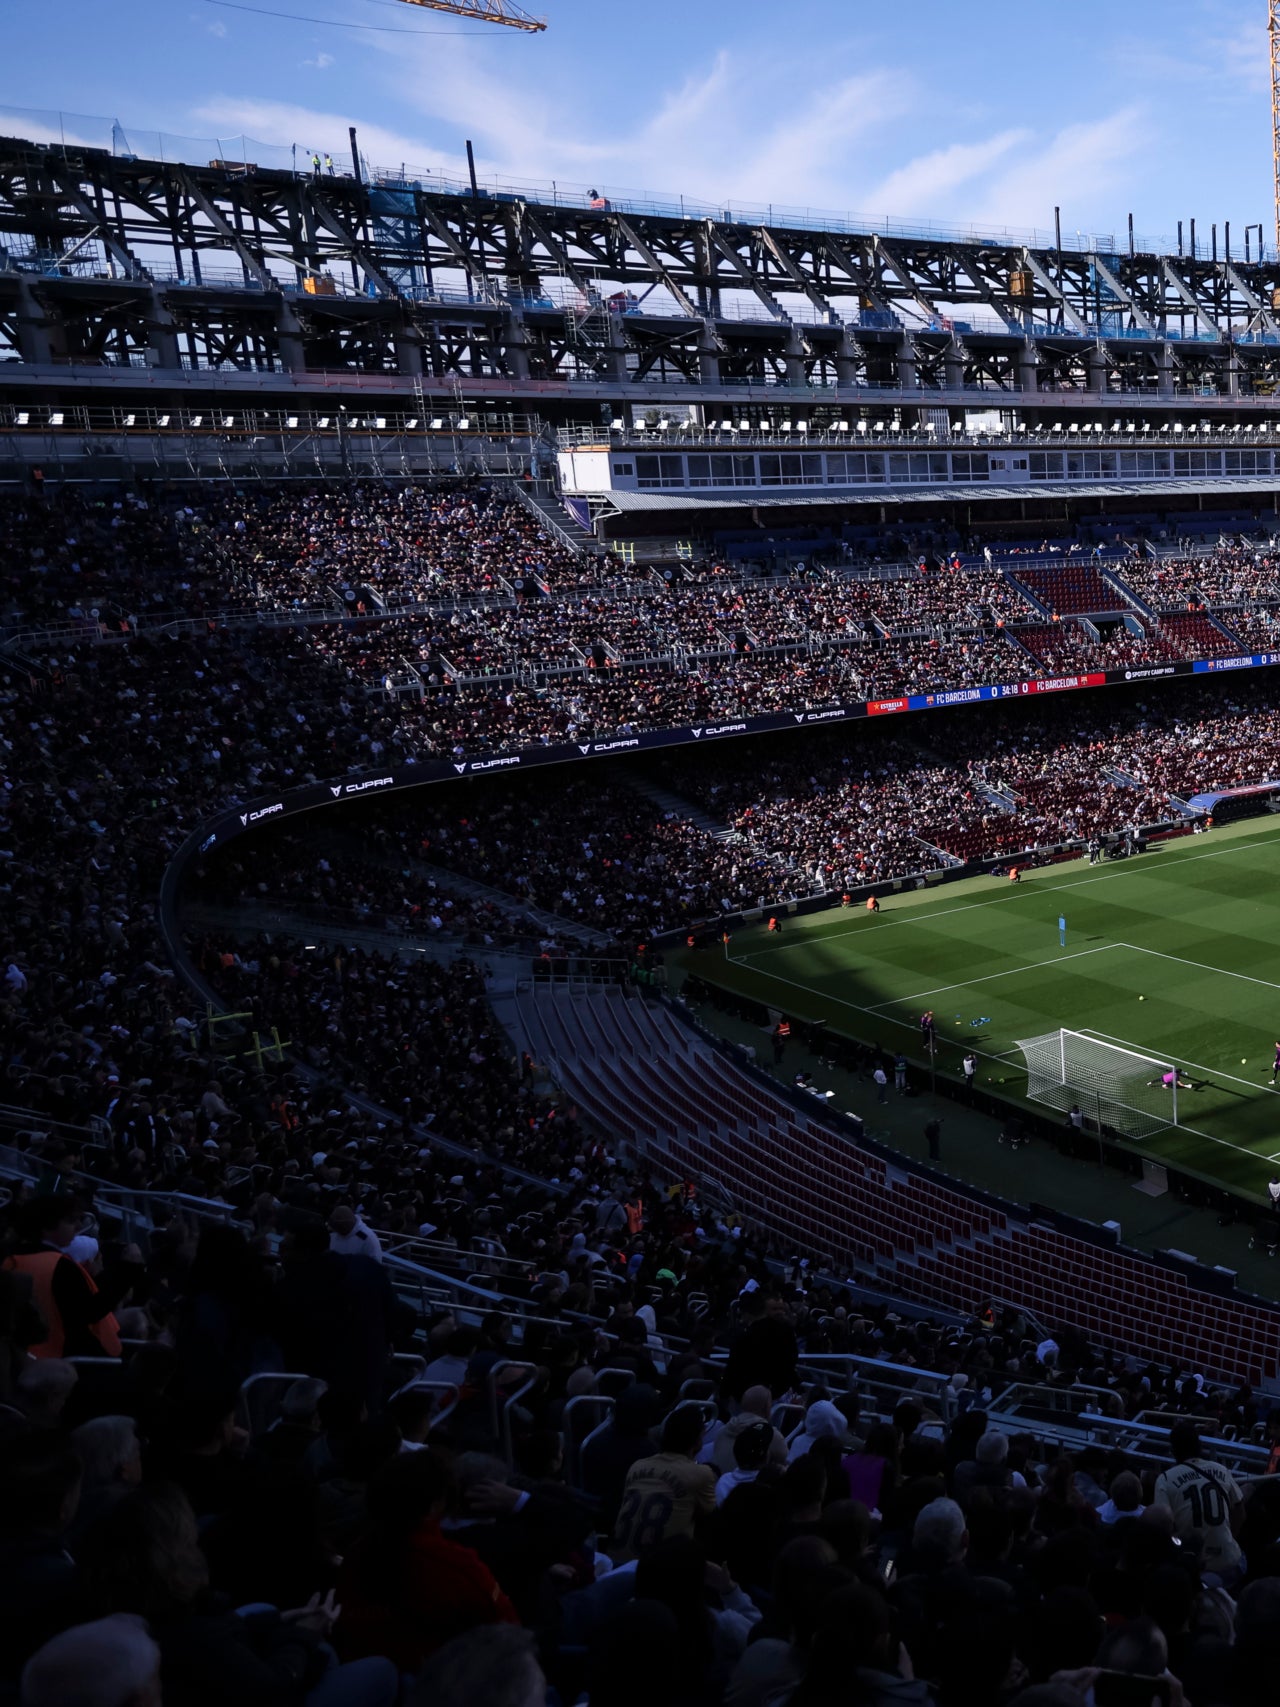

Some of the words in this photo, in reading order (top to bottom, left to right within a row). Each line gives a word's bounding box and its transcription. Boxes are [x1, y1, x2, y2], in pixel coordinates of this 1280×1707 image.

[1216, 660, 1224, 669] FC
[1224, 657, 1253, 669] BARCELONA
[1261, 655, 1267, 664] 0
[936, 695, 945, 704] FC
[945, 690, 981, 703] BARCELONA
[991, 686, 998, 698] 0
[1002, 684, 1019, 696] 34:18
[1022, 682, 1028, 693] 0
[1037, 681, 1044, 691] FC
[1045, 677, 1078, 690] BARCELONA
[807, 709, 845, 720] CUPRA
[705, 723, 746, 735] CUPRA
[594, 738, 639, 751] CUPRA
[471, 756, 520, 770] CUPRA
[346, 777, 393, 792] CUPRA
[250, 803, 283, 821] CUPRA
[1183, 1482, 1225, 1528] 10
